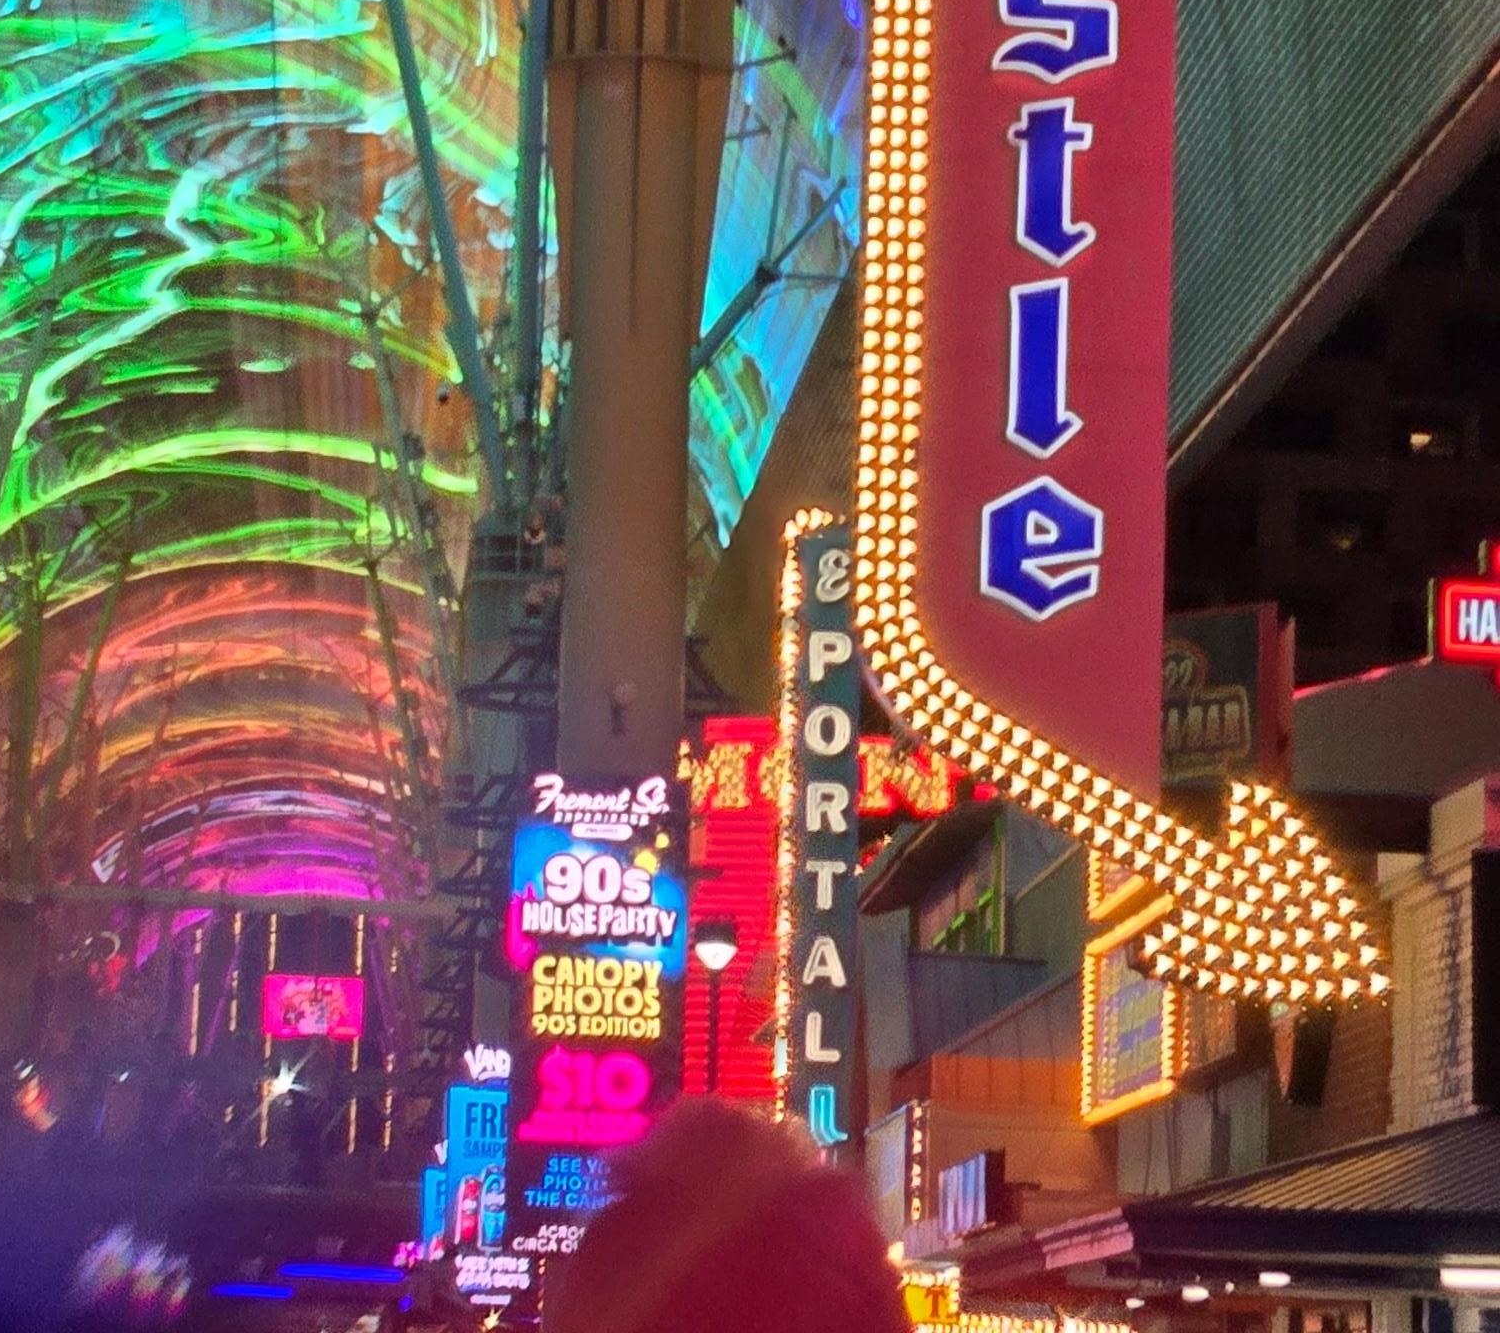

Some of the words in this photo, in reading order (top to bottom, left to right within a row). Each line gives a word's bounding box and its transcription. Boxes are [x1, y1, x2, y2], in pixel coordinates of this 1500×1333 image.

[533, 773, 632, 814] Fremont
[544, 853, 652, 904] 90s
[532, 954, 663, 989] CANOPY
[532, 984, 662, 1018] PHOTOS
[579, 1015, 661, 1039] EDITION
[536, 1044, 651, 1110] $10
[548, 1157, 581, 1173] SEE
[525, 1190, 560, 1207] THE
